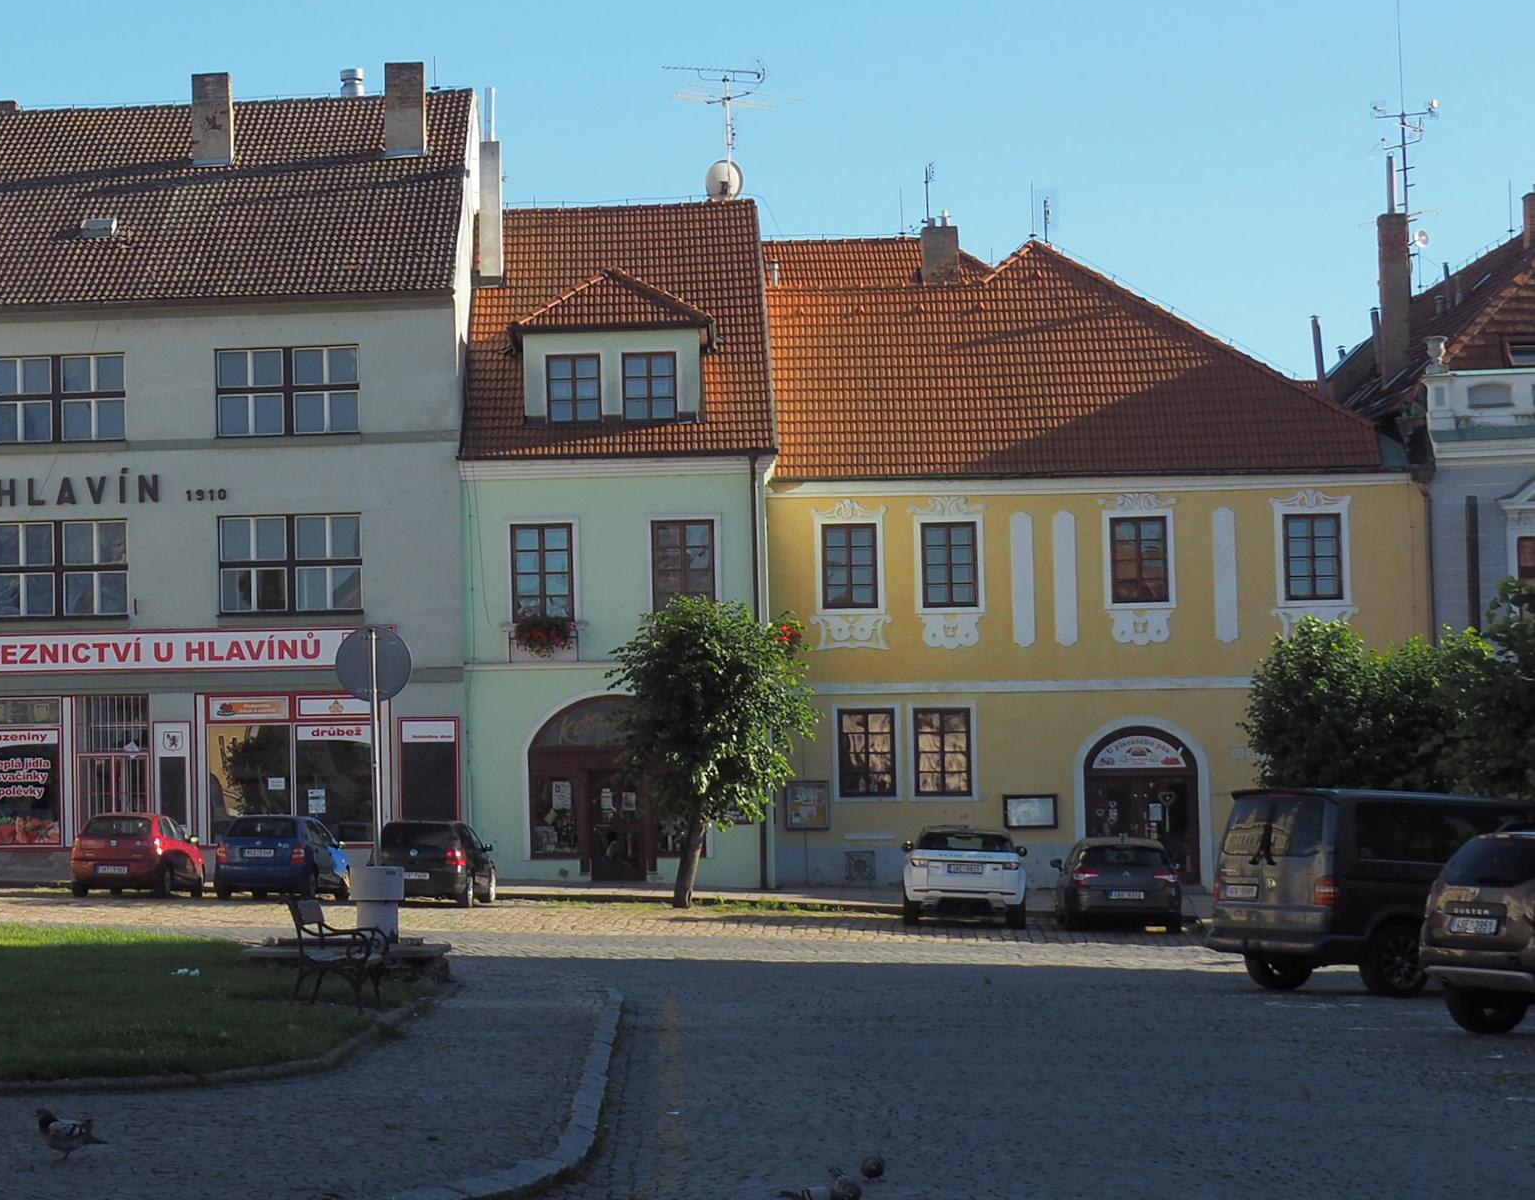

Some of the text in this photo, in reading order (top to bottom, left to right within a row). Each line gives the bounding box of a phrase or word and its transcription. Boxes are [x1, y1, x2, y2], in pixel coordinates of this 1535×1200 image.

[186, 488, 227, 502] 1910
[154, 642, 174, 662] U
[185, 632, 321, 661] HLAVÍNŮ
[311, 726, 363, 737] drůbež
